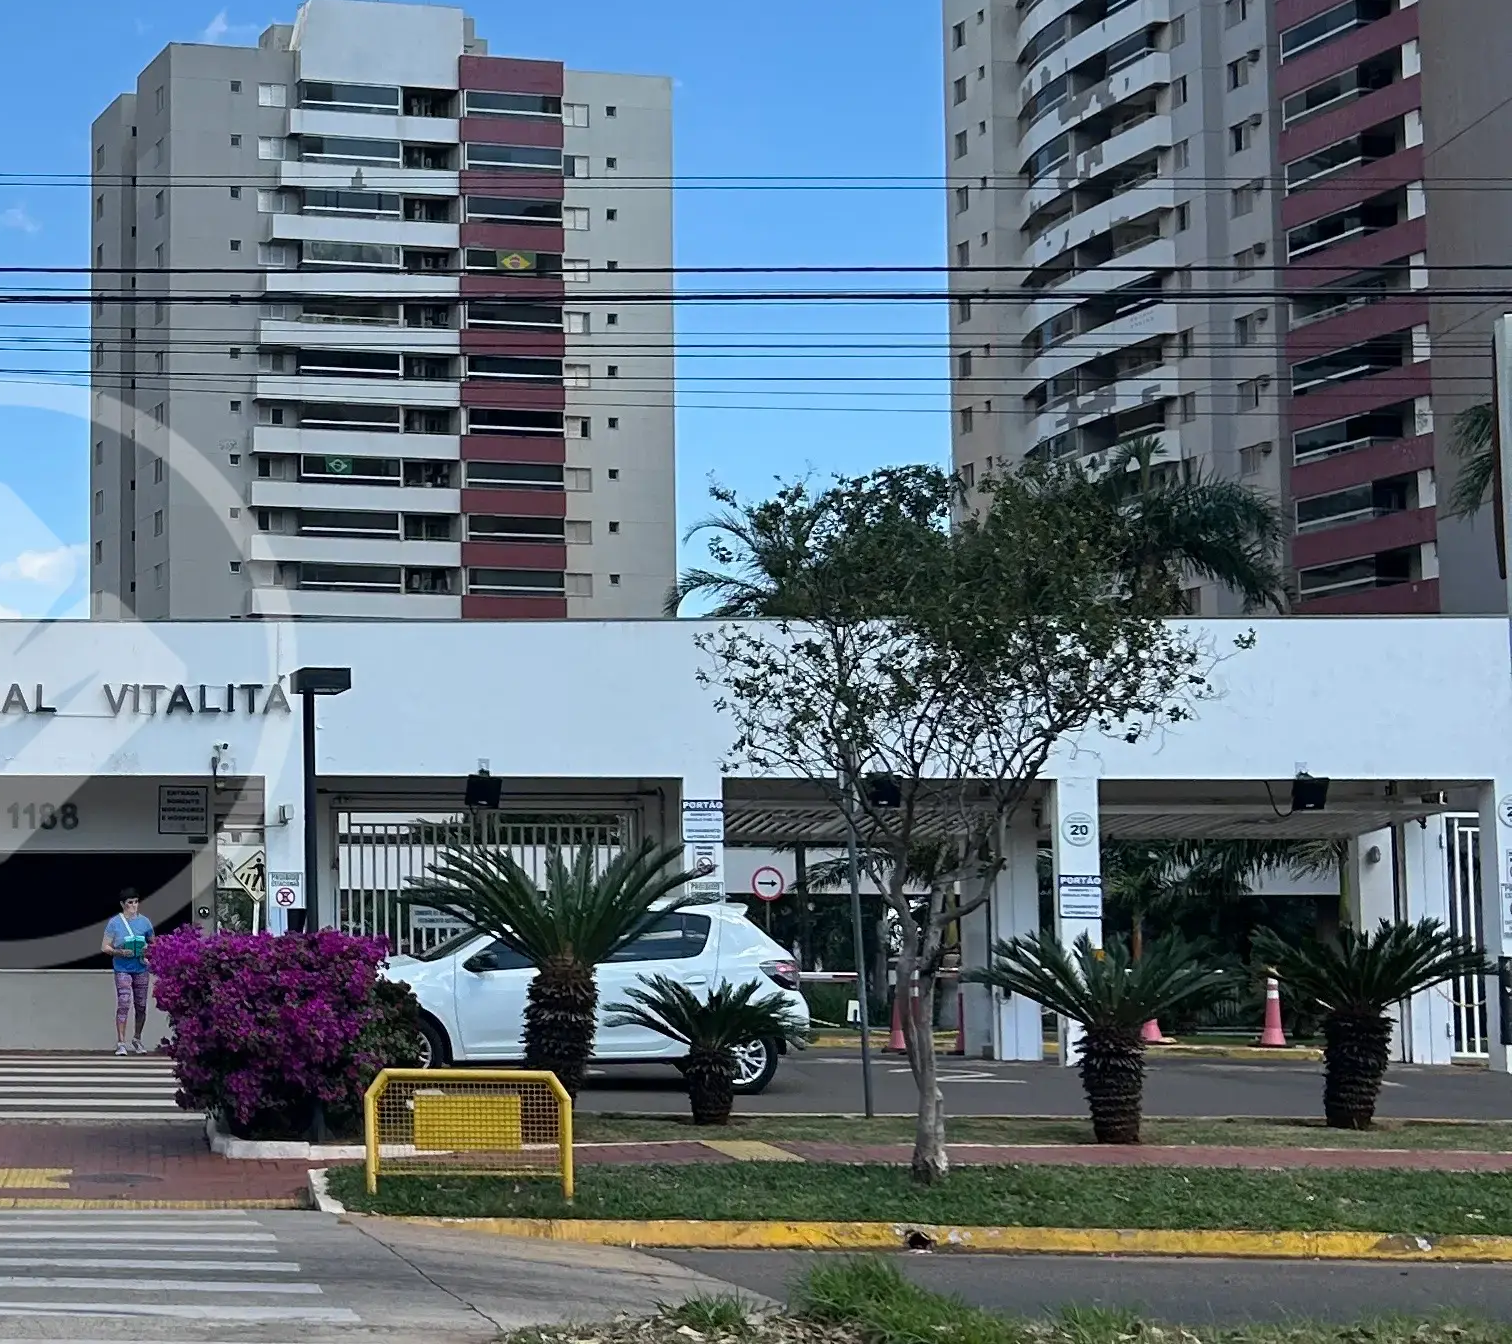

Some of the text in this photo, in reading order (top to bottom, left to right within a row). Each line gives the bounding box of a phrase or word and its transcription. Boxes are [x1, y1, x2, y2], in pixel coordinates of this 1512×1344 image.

[103, 675, 292, 715] VITALITÁ
[682, 800, 724, 809] PORTÃO
[1070, 824, 1089, 836] 20
[1059, 875, 1102, 885] PORTÃO
